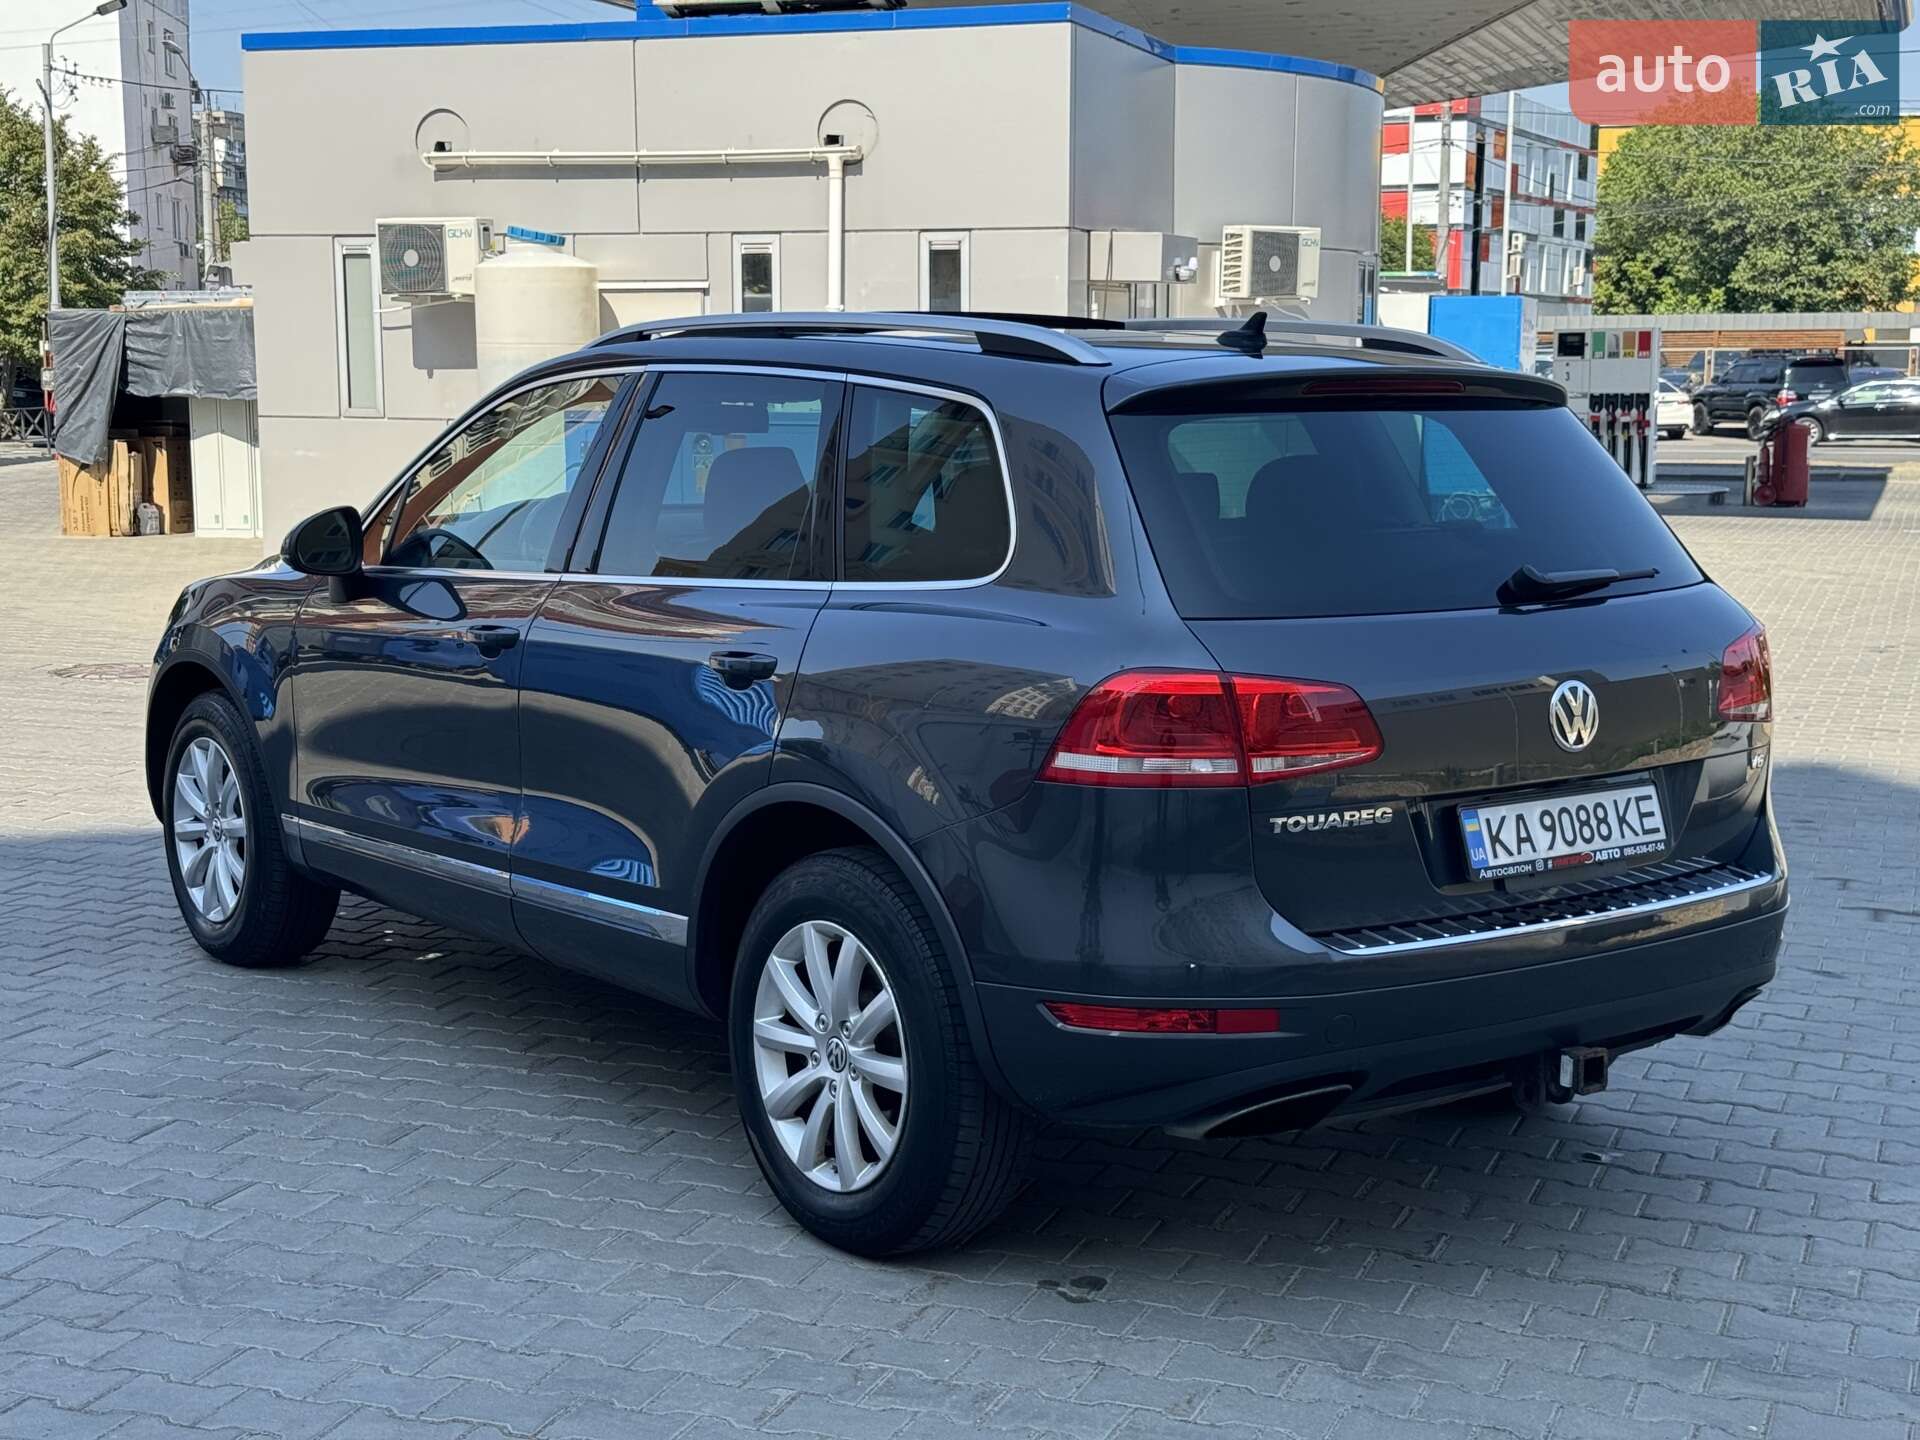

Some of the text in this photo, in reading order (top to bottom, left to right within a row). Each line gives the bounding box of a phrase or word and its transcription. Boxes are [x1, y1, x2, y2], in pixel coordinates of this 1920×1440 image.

[1564, 371, 1570, 381] 3
[1269, 806, 1393, 834] TOUAREG
[1485, 794, 1661, 859] KA 9088 KE
[1470, 848, 1487, 862] UA
[1479, 863, 1532, 880] Автосалон
[1595, 849, 1621, 862] АВТО
